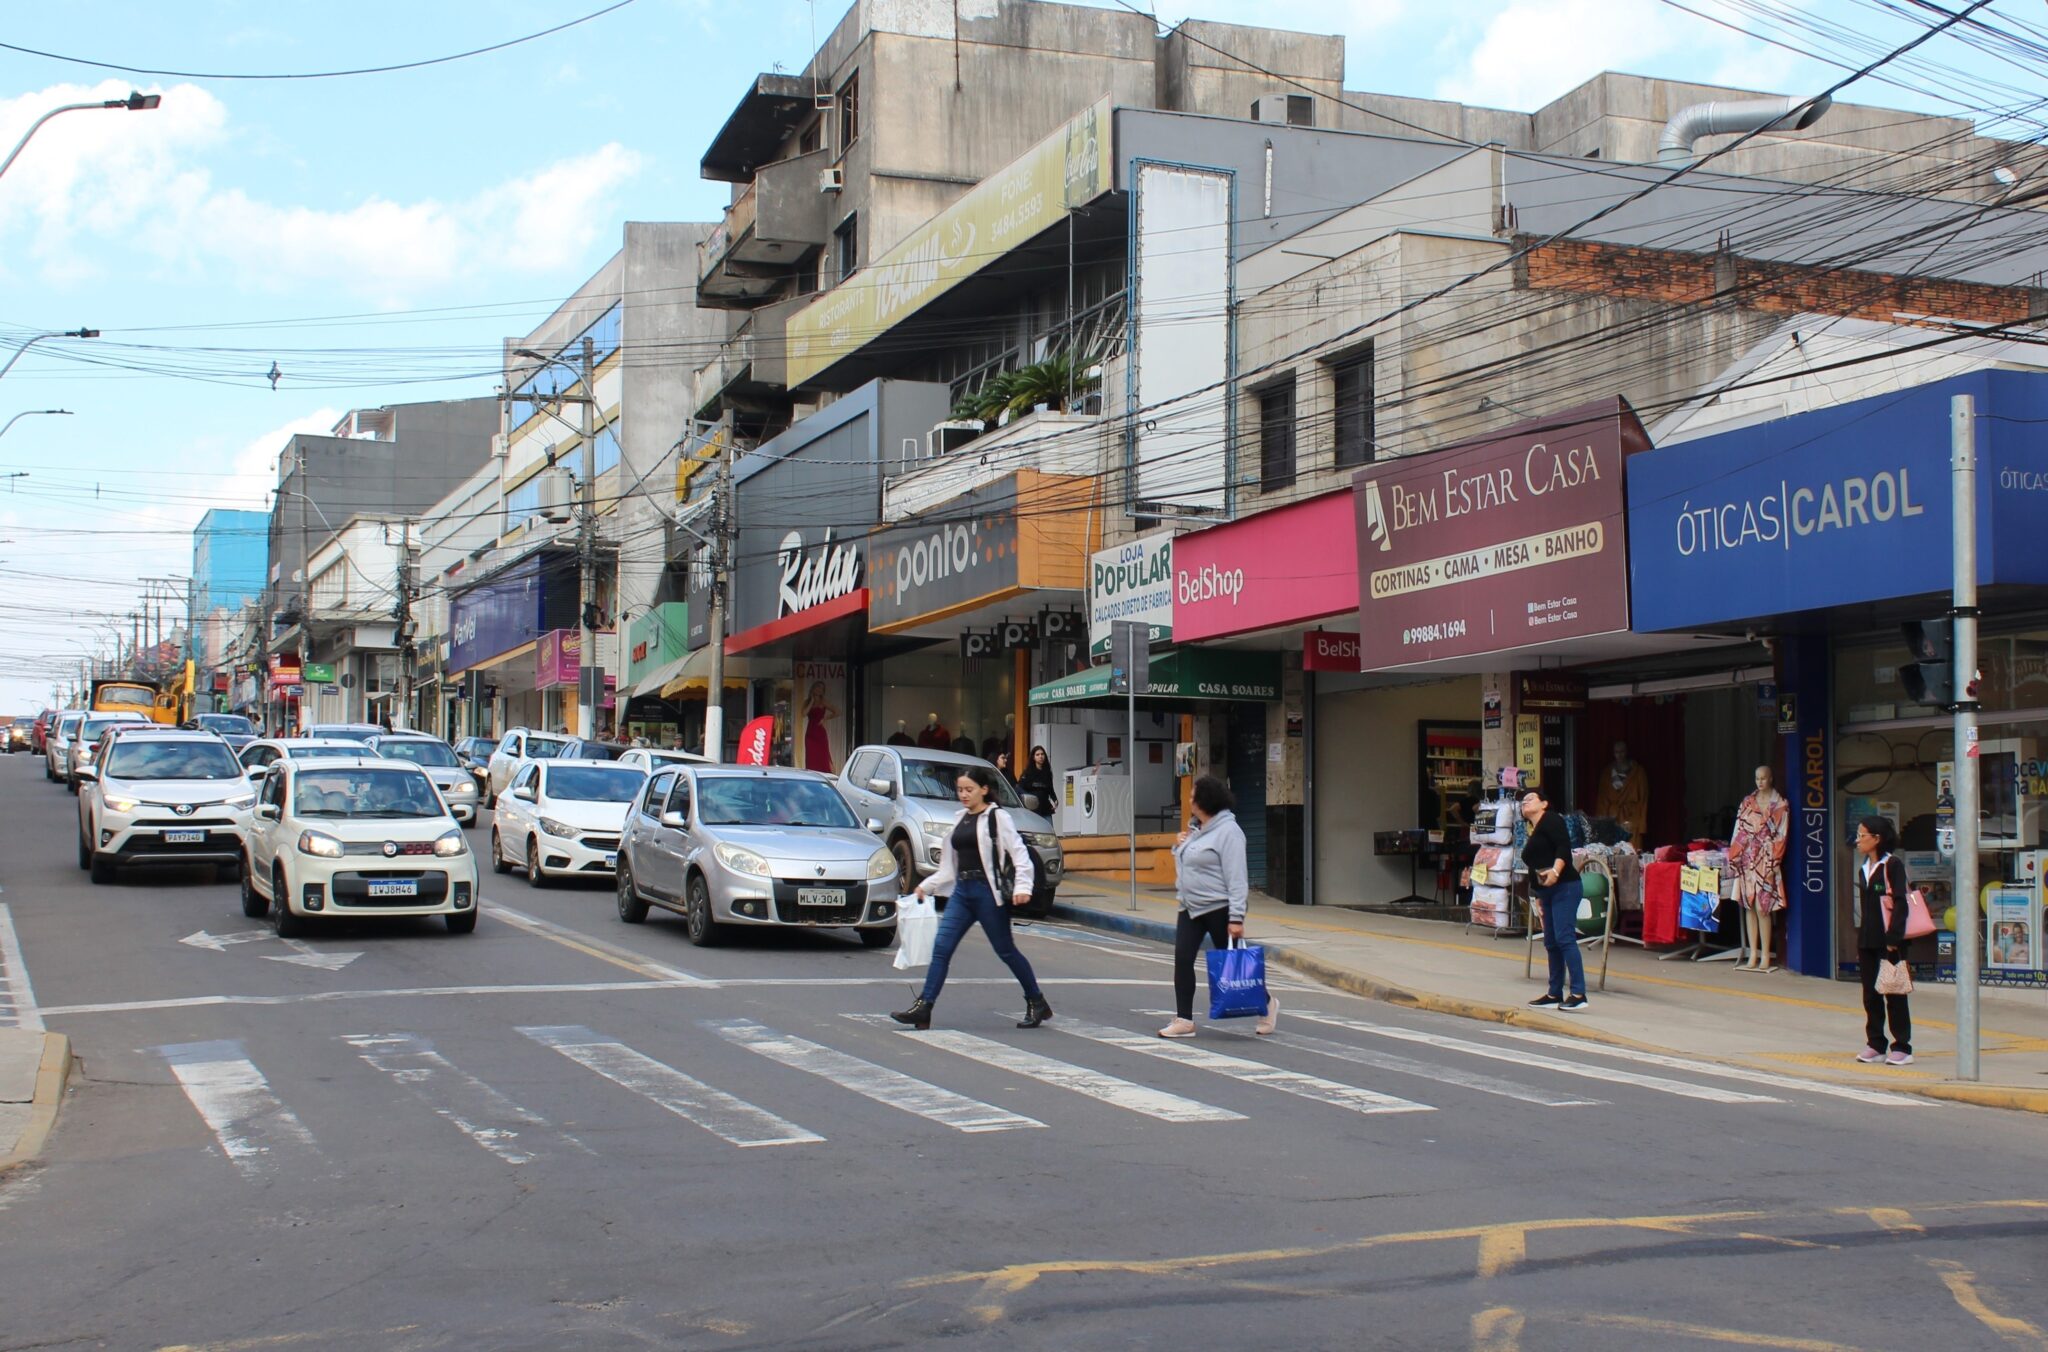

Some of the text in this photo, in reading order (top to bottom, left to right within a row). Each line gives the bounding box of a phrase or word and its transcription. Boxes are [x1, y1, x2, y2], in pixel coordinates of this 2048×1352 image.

[820, 287, 865, 328] RISTORANTE
[1391, 443, 1601, 532] BEM ESTAR CASA
[1676, 468, 1924, 556] ÓTICAS CAROL
[778, 526, 859, 619] Radan
[1095, 542, 1171, 598] POPULAR
[1120, 544, 1143, 564] LOJA
[1374, 527, 1599, 593] CORTINAS CAMA MESA BANHO
[1178, 563, 1244, 606] BelShop
[1095, 602, 1121, 624] CALÇADOS
[1122, 596, 1140, 617] DIRETO
[1141, 596, 1148, 612] DE
[1533, 597, 1577, 612] Bem Estar Casa
[1534, 611, 1578, 626] Bem Estar Casa
[1318, 639, 1360, 657] BelSh
[1411, 619, 1466, 644] 99884.1694
[1147, 682, 1275, 696] OPULAR CASA SOARES
[747, 728, 767, 767] dan
[1802, 728, 1824, 893] ÓTICAS CAROL
[373, 885, 412, 895] IWJ8H46
